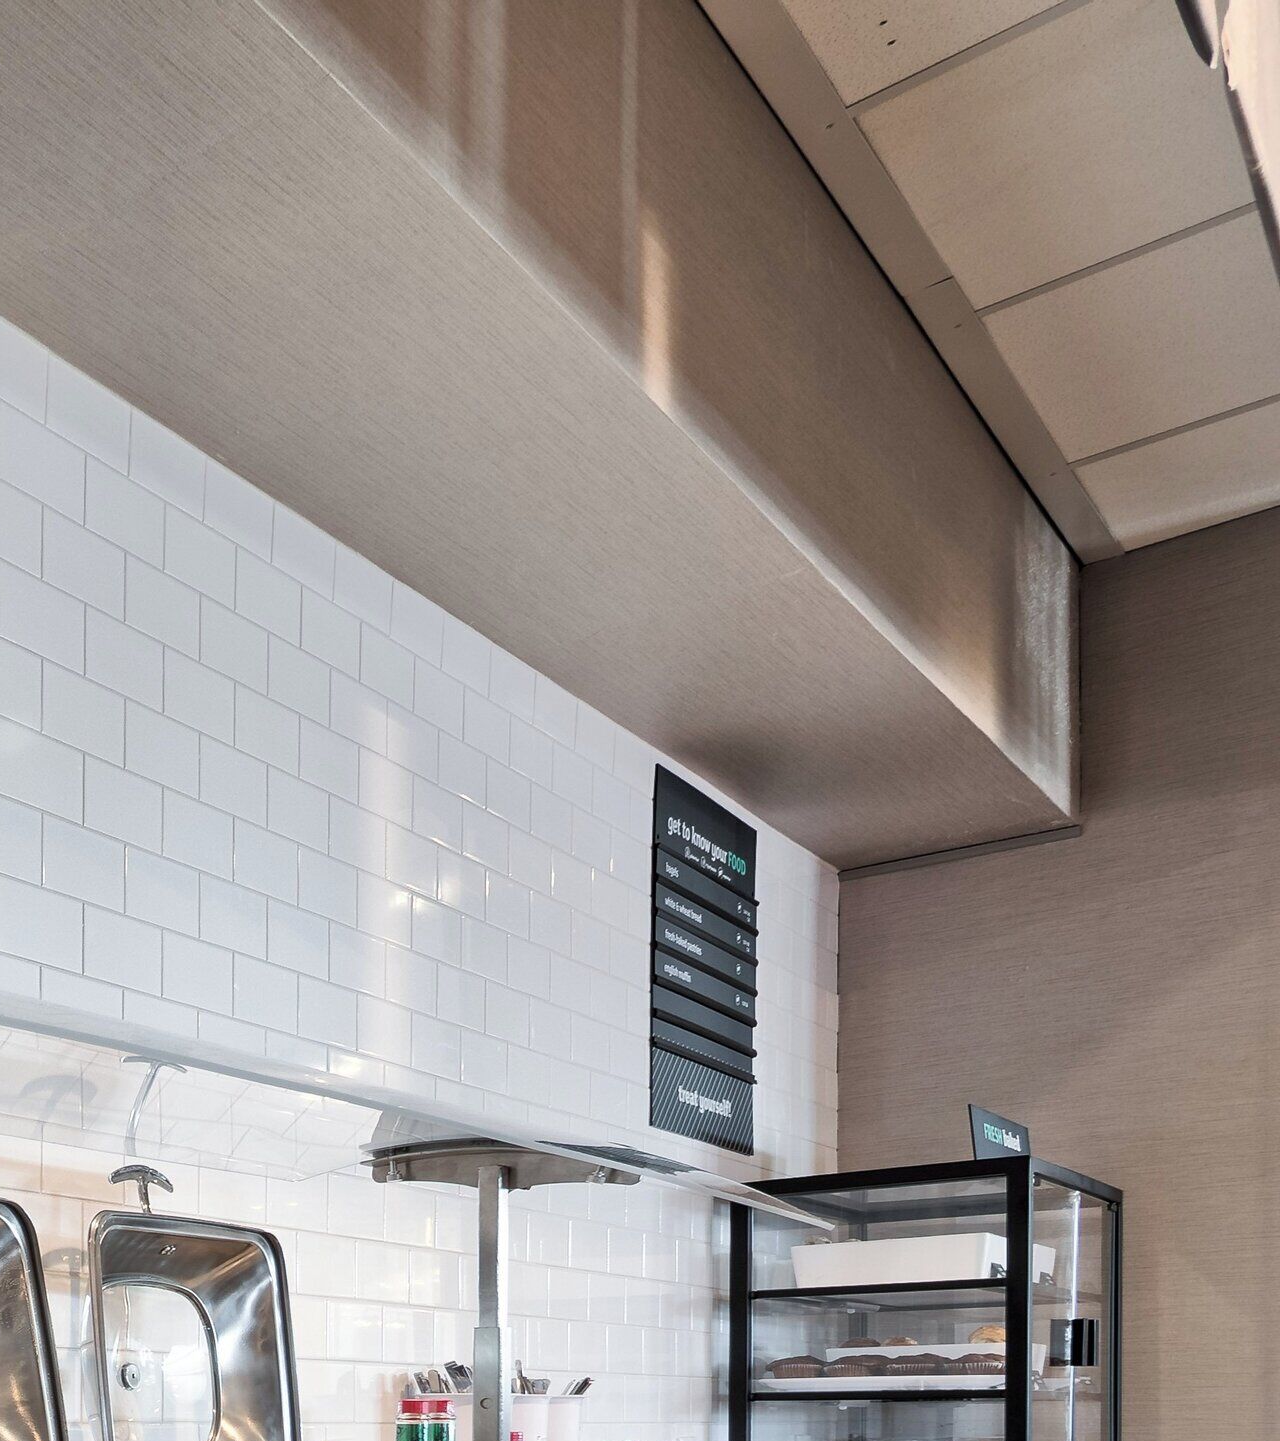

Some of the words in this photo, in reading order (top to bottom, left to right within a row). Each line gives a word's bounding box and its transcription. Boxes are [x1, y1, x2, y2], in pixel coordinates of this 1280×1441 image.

[667, 817, 681, 836] get
[682, 822, 691, 841] to
[691, 826, 711, 853] know
[711, 843, 728, 864] your
[727, 851, 746, 876] FOOD
[678, 1085, 699, 1107] treat
